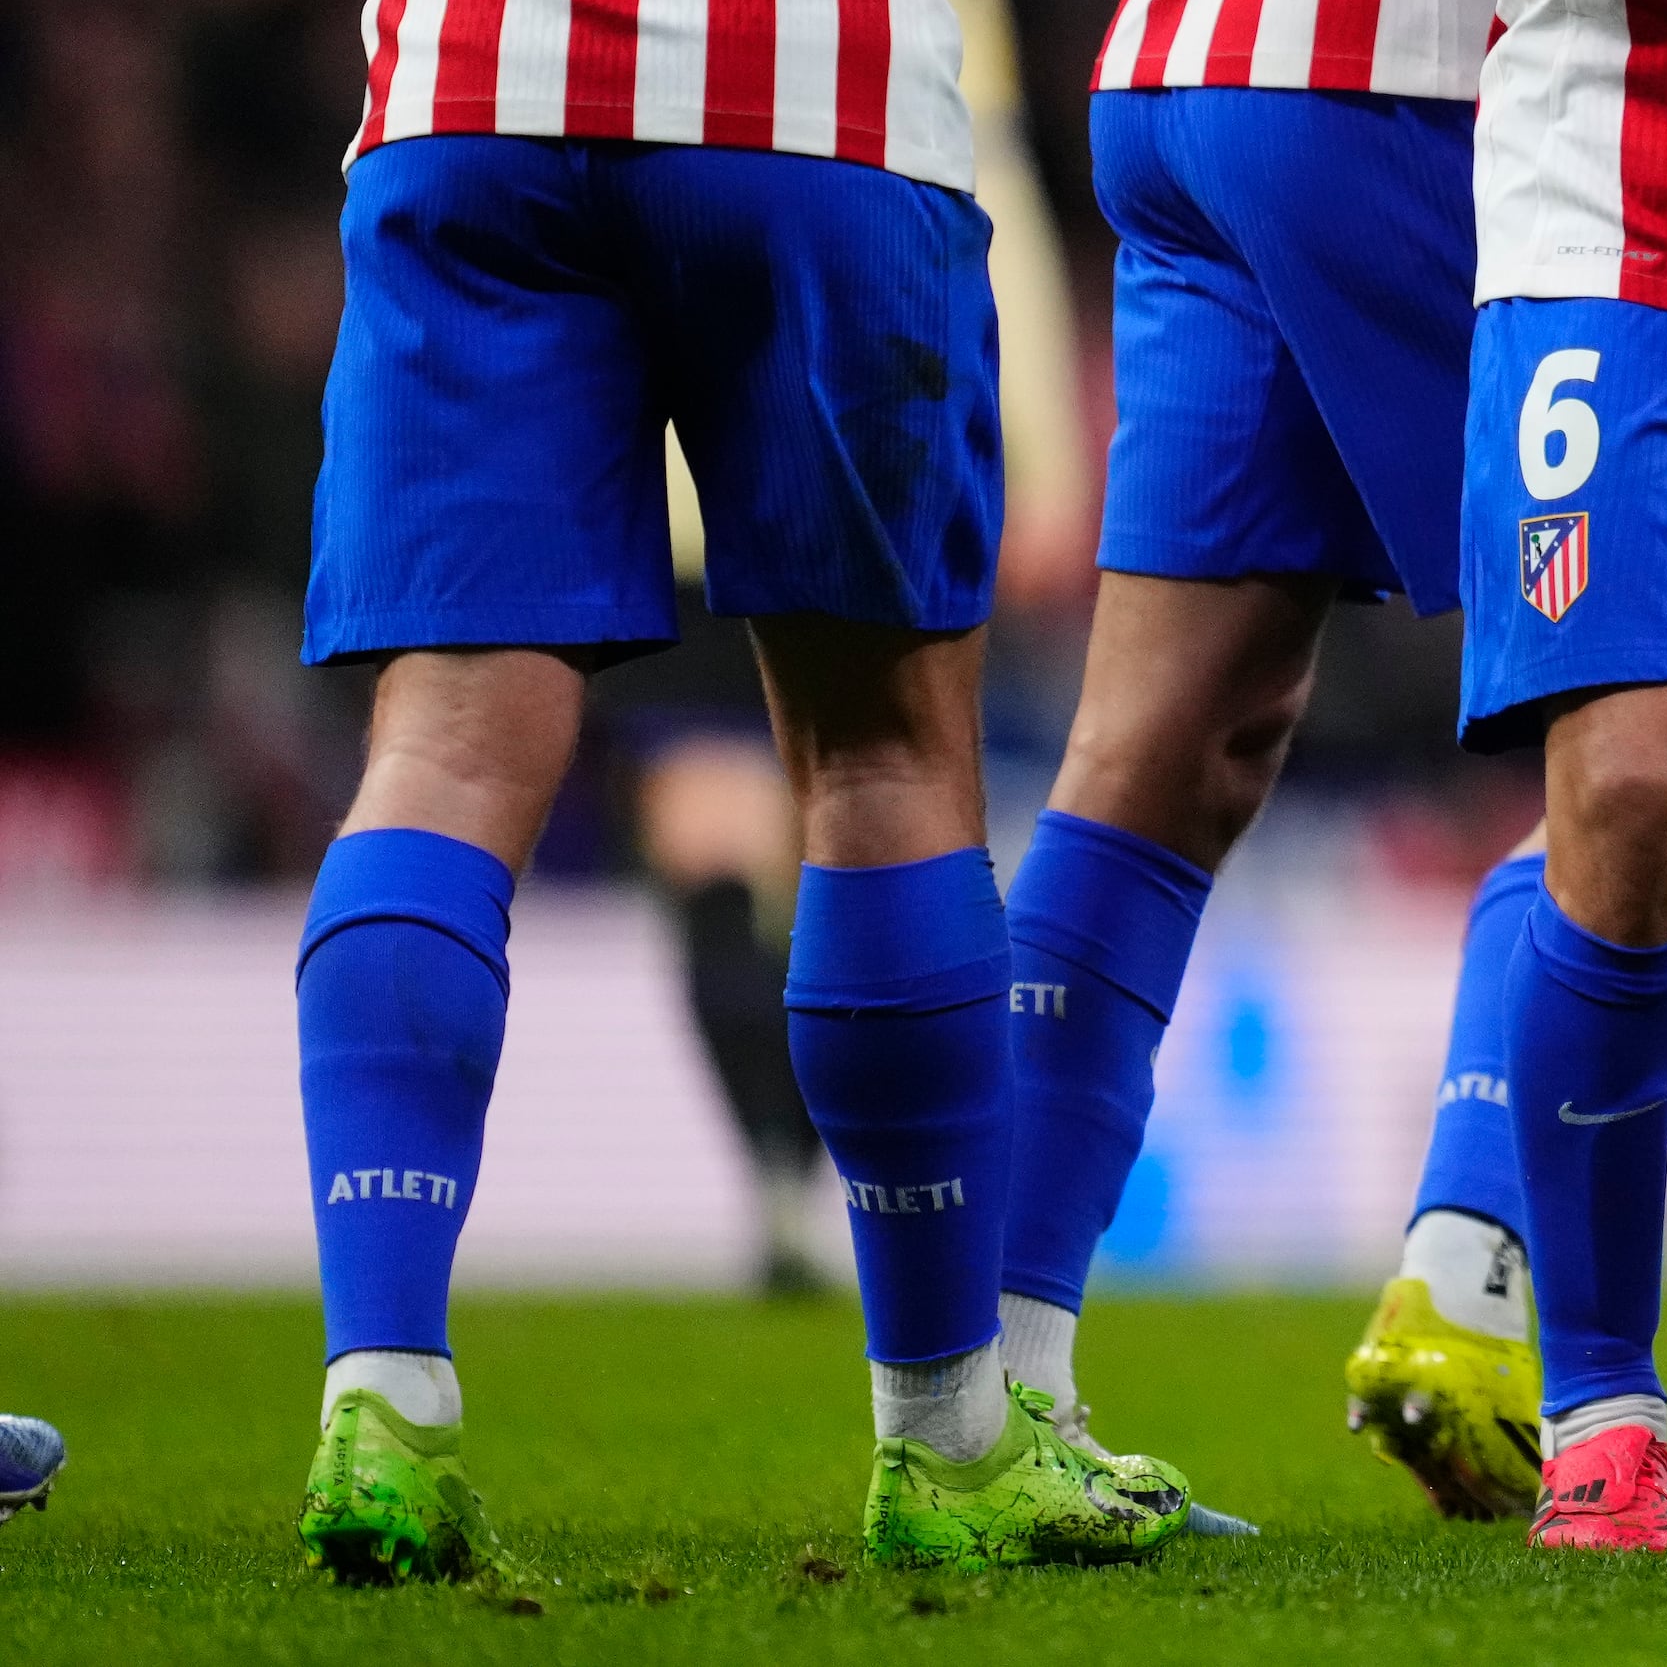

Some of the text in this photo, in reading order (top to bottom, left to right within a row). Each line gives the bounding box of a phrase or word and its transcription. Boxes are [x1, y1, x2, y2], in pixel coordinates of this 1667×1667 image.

[1517, 348, 1601, 501] 6
[1009, 981, 1067, 1020] ETI
[326, 1167, 457, 1210] ATLETI
[840, 1174, 966, 1214] ATLETI
